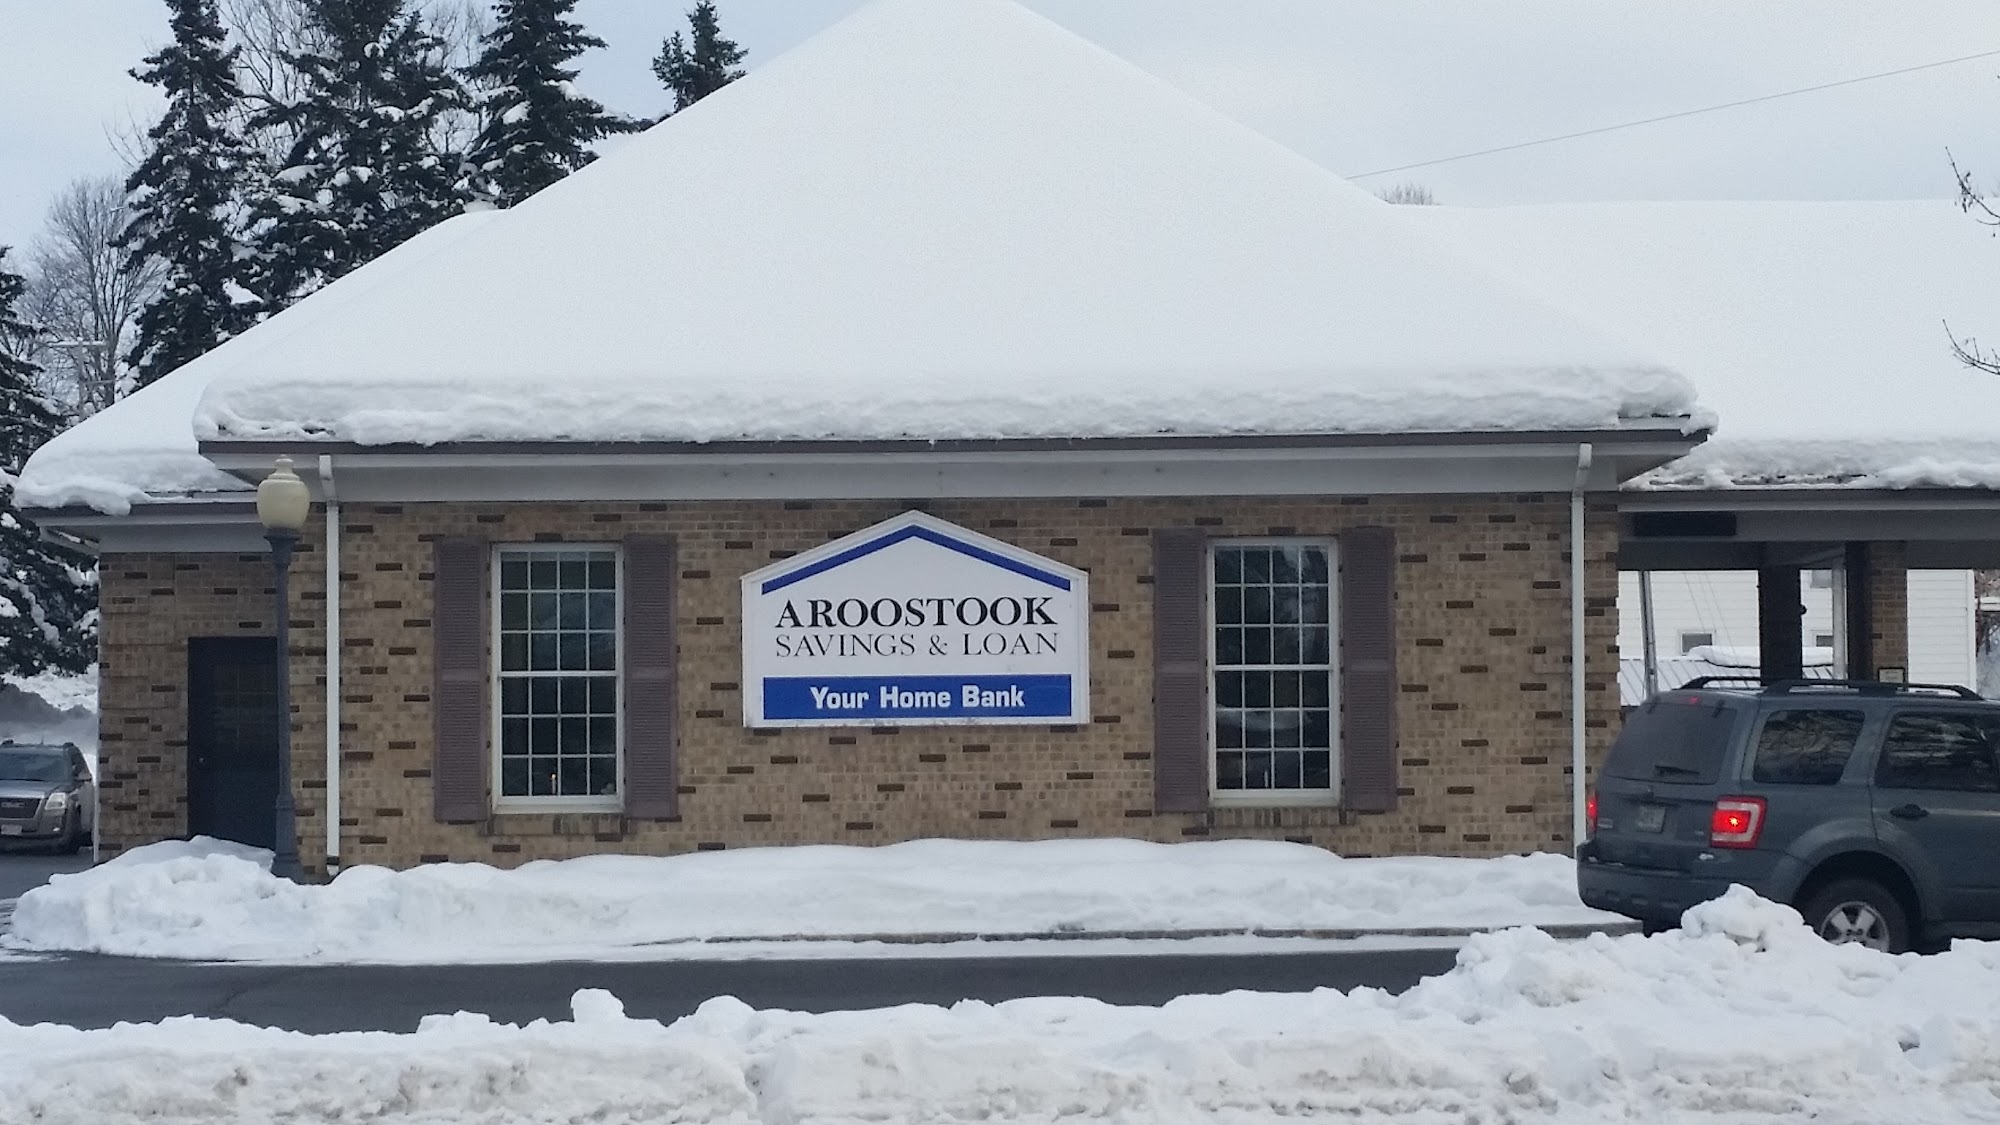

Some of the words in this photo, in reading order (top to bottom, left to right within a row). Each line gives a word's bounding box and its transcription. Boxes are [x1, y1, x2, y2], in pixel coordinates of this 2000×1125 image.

[775, 597, 1058, 628] AROOSTOOK
[776, 633, 915, 657] SAVINGS
[929, 635, 948, 656] &
[963, 632, 1058, 656] LOAN
[811, 686, 869, 709] Your
[880, 686, 951, 709] Home
[962, 685, 1025, 708] Bank
